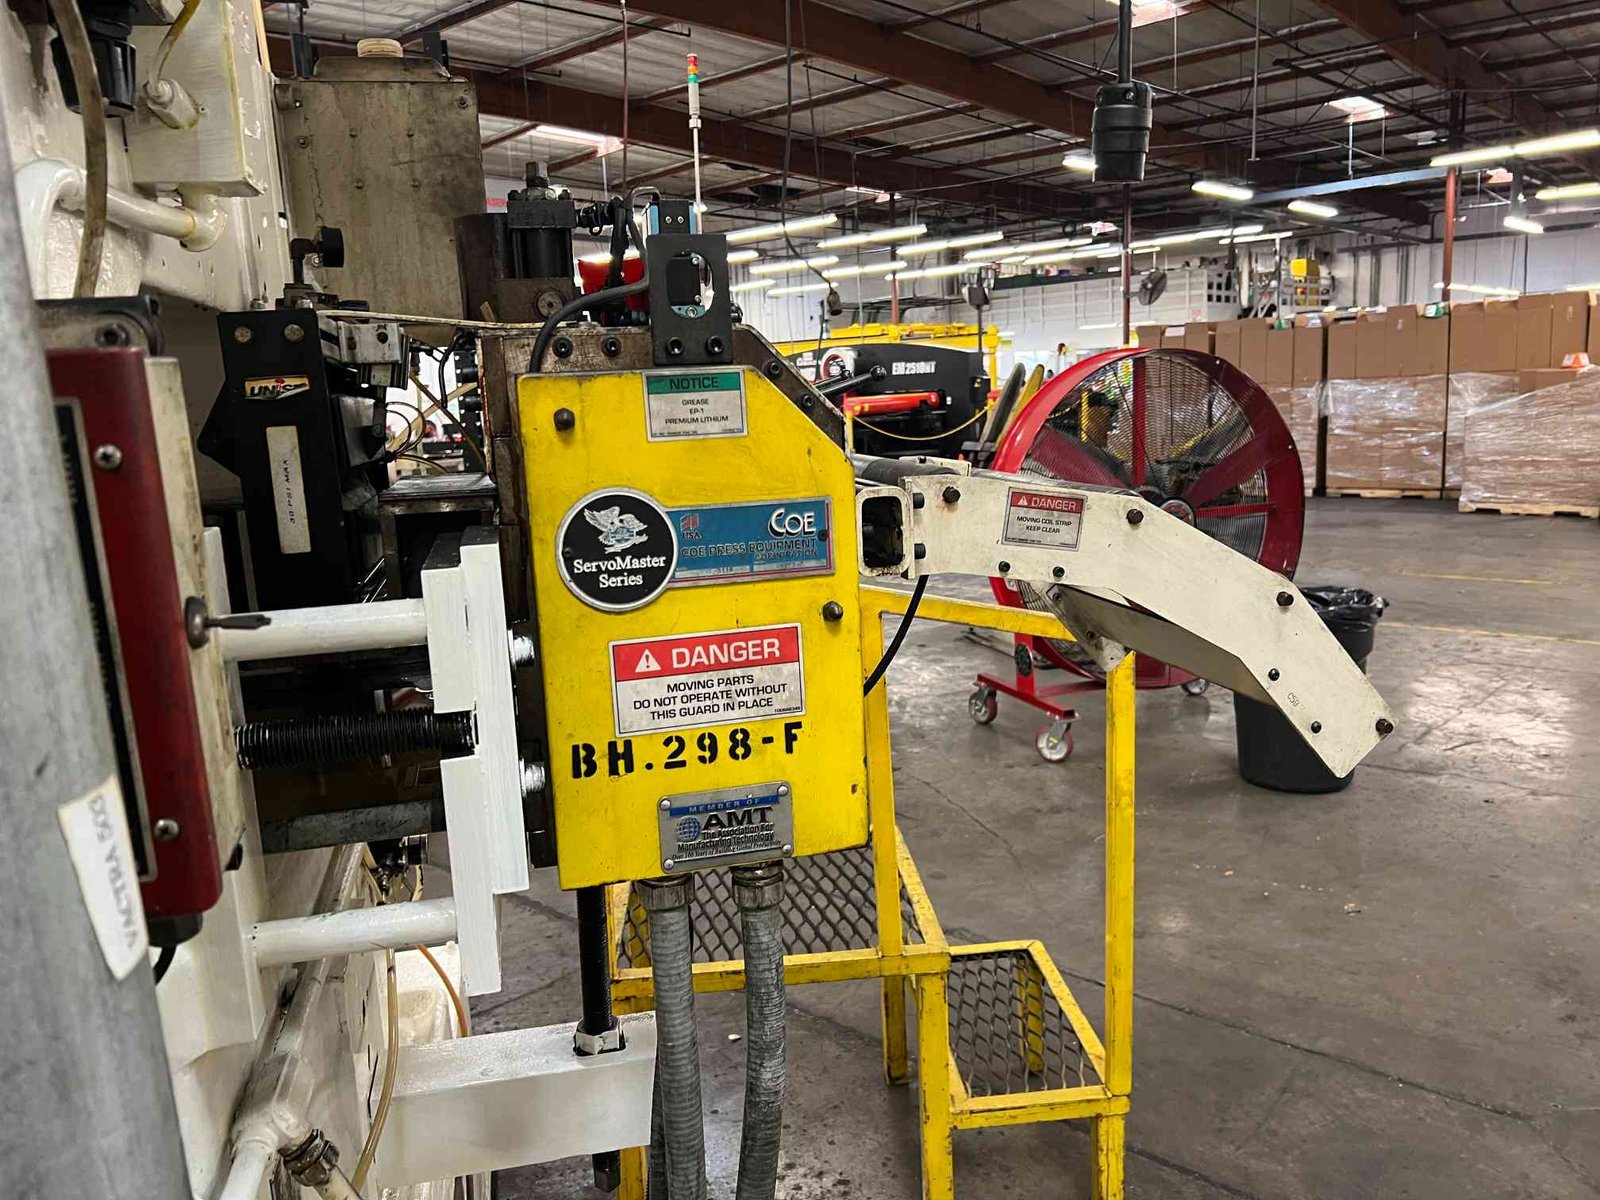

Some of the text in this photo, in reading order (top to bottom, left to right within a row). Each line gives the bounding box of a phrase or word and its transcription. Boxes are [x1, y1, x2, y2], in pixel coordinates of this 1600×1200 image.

[669, 376, 719, 390] NOTICE
[1031, 497, 1076, 511] DANGER
[1016, 515, 1040, 524] MOVING
[682, 530, 701, 540] USA
[681, 538, 817, 558] COE PRESS EQUIPMENT
[573, 555, 666, 574] ServoMaster
[599, 572, 643, 588] Series
[672, 638, 780, 669] DANGER
[667, 675, 754, 693] MOVING PARTS
[633, 683, 788, 710] DO NOT OPERATE WITHOUT
[650, 708, 676, 721] THIS
[679, 703, 720, 717] GUARD
[723, 702, 735, 712] IN
[738, 698, 773, 710] PLACE
[688, 798, 760, 813] MEMBER OF
[703, 805, 774, 830] AMT
[702, 822, 774, 840] The Association For
[677, 831, 775, 852] Manufacturing Technology
